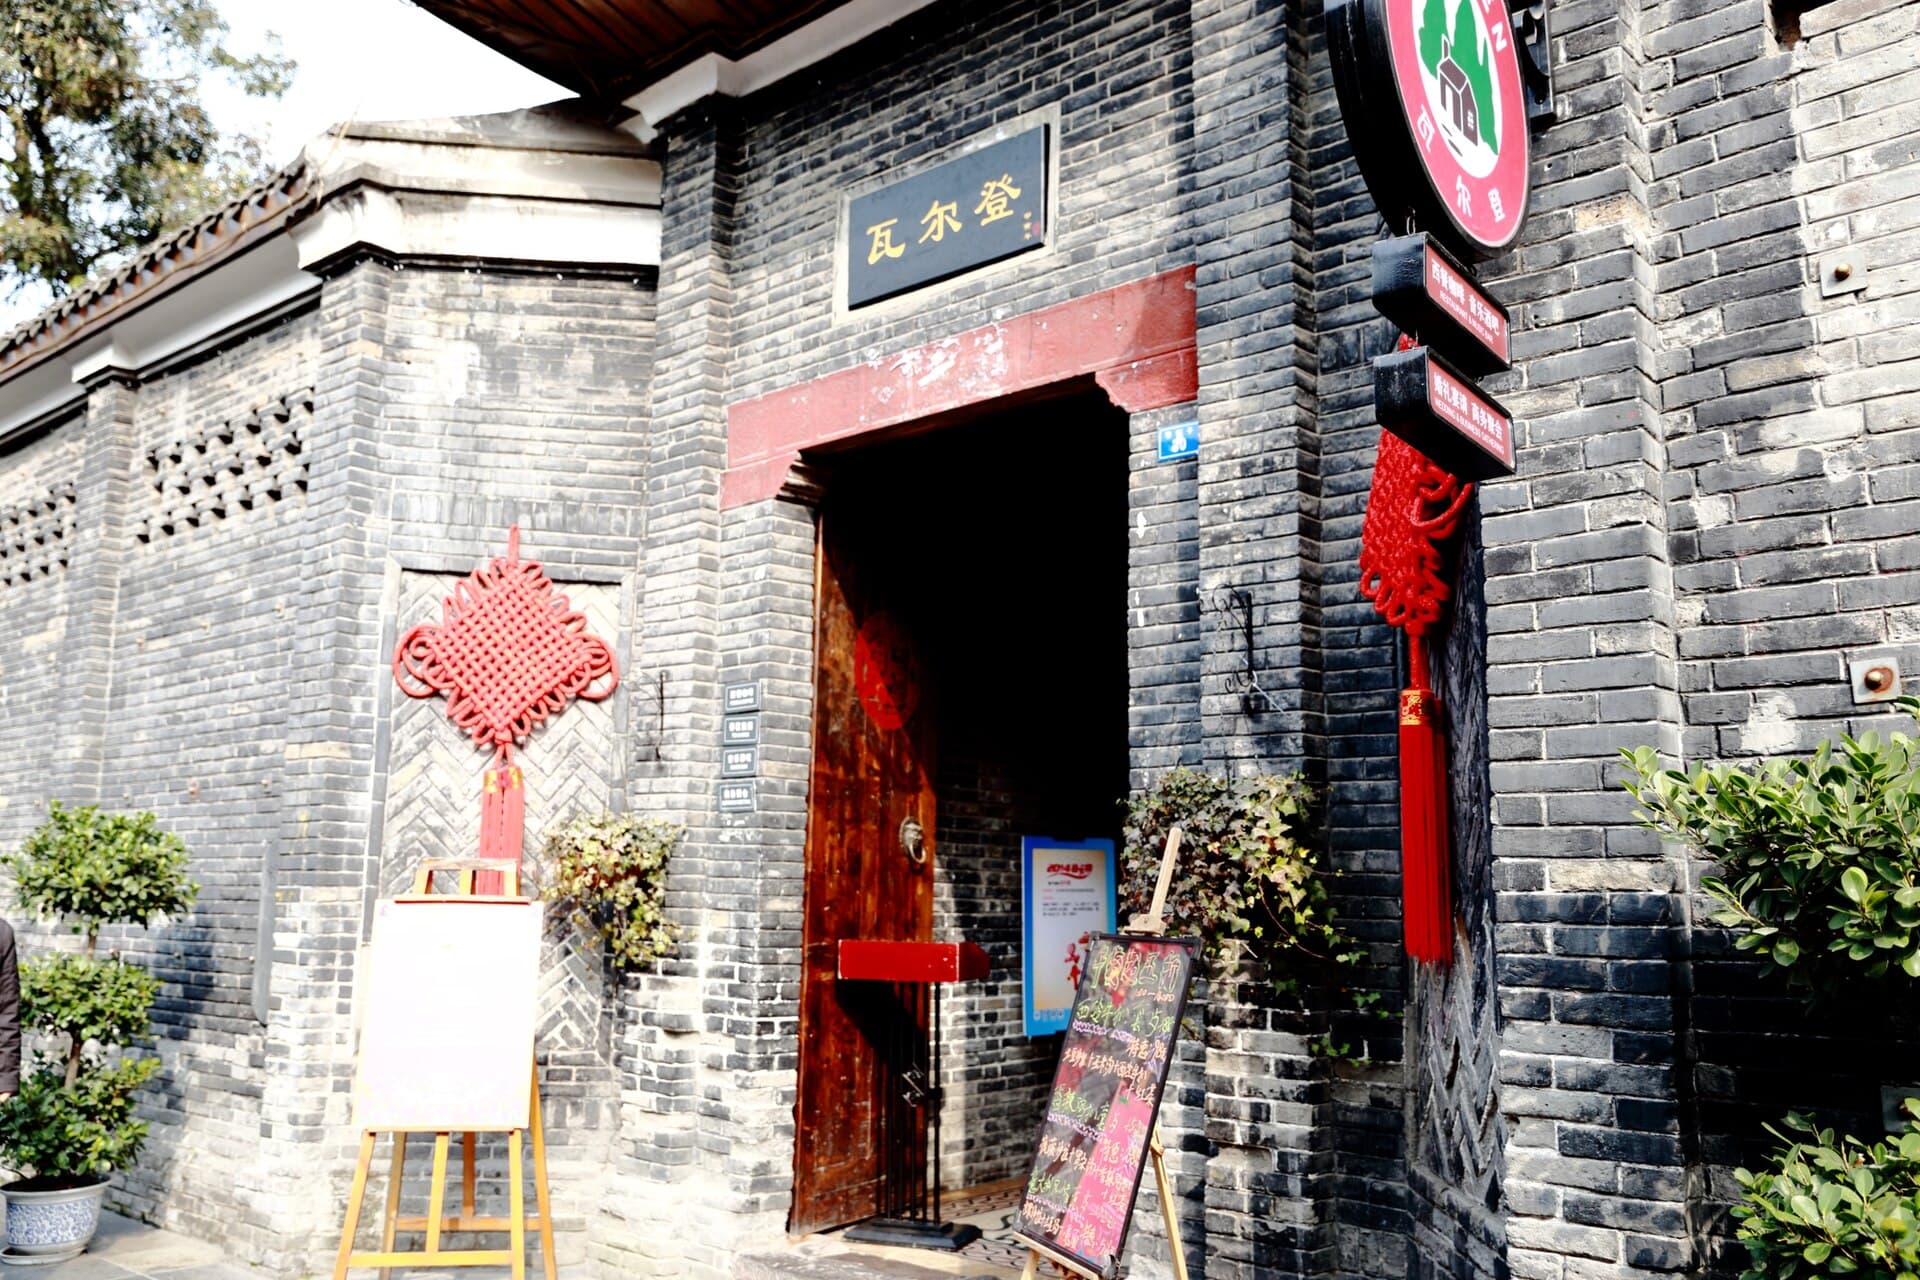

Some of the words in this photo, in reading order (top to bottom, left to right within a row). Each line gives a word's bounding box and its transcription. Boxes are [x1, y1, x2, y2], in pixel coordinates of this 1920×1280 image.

[865, 173, 1022, 266] 瓦尔登
[1468, 293, 1500, 337] 音乐酒吧
[1471, 399, 1502, 441] 商务聚会
